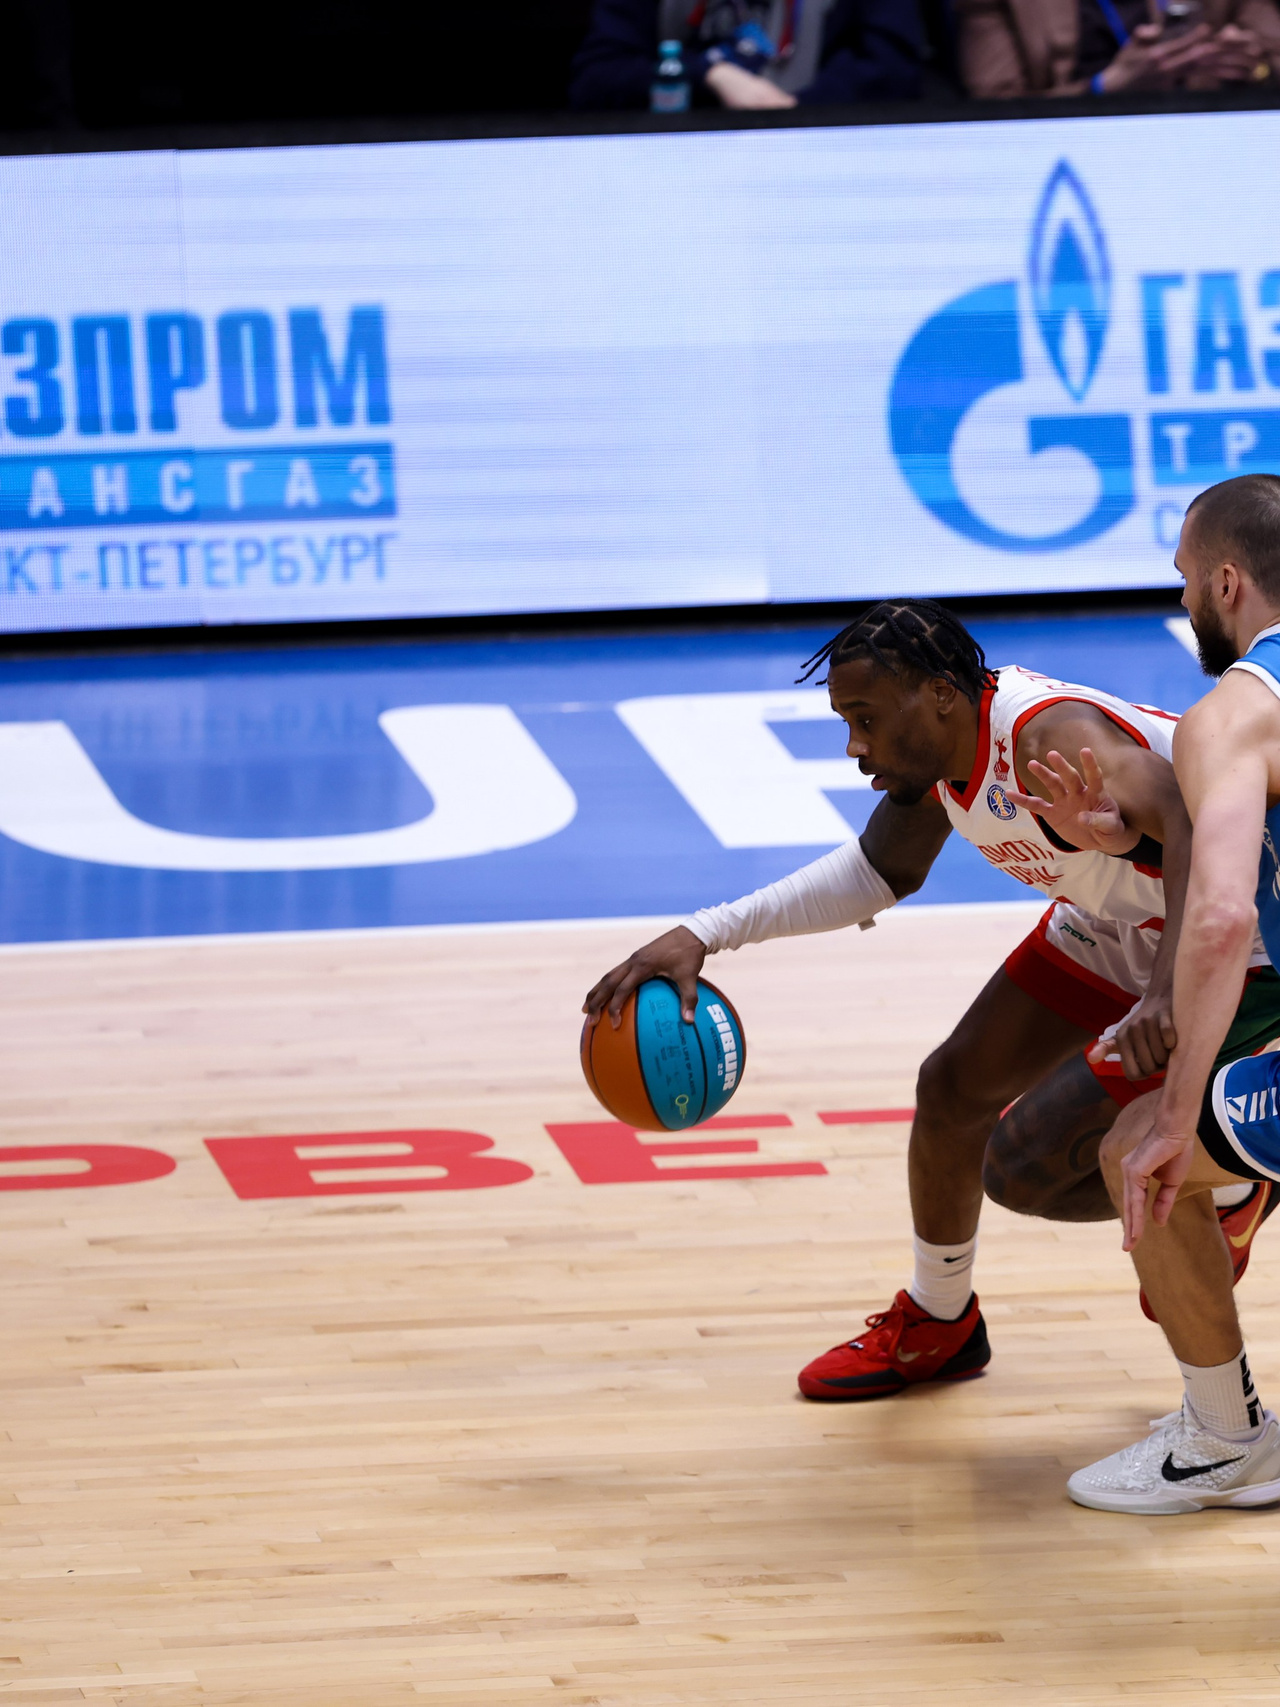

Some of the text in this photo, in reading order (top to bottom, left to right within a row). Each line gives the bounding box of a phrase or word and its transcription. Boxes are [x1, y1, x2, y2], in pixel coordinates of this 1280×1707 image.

[2, 303, 393, 440] ЗПРОМ
[27, 455, 383, 519] АНСГАЗ
[3, 532, 398, 593] КТ-ПЕТЕРБУРГ
[706, 1003, 738, 1092] SIBUR
